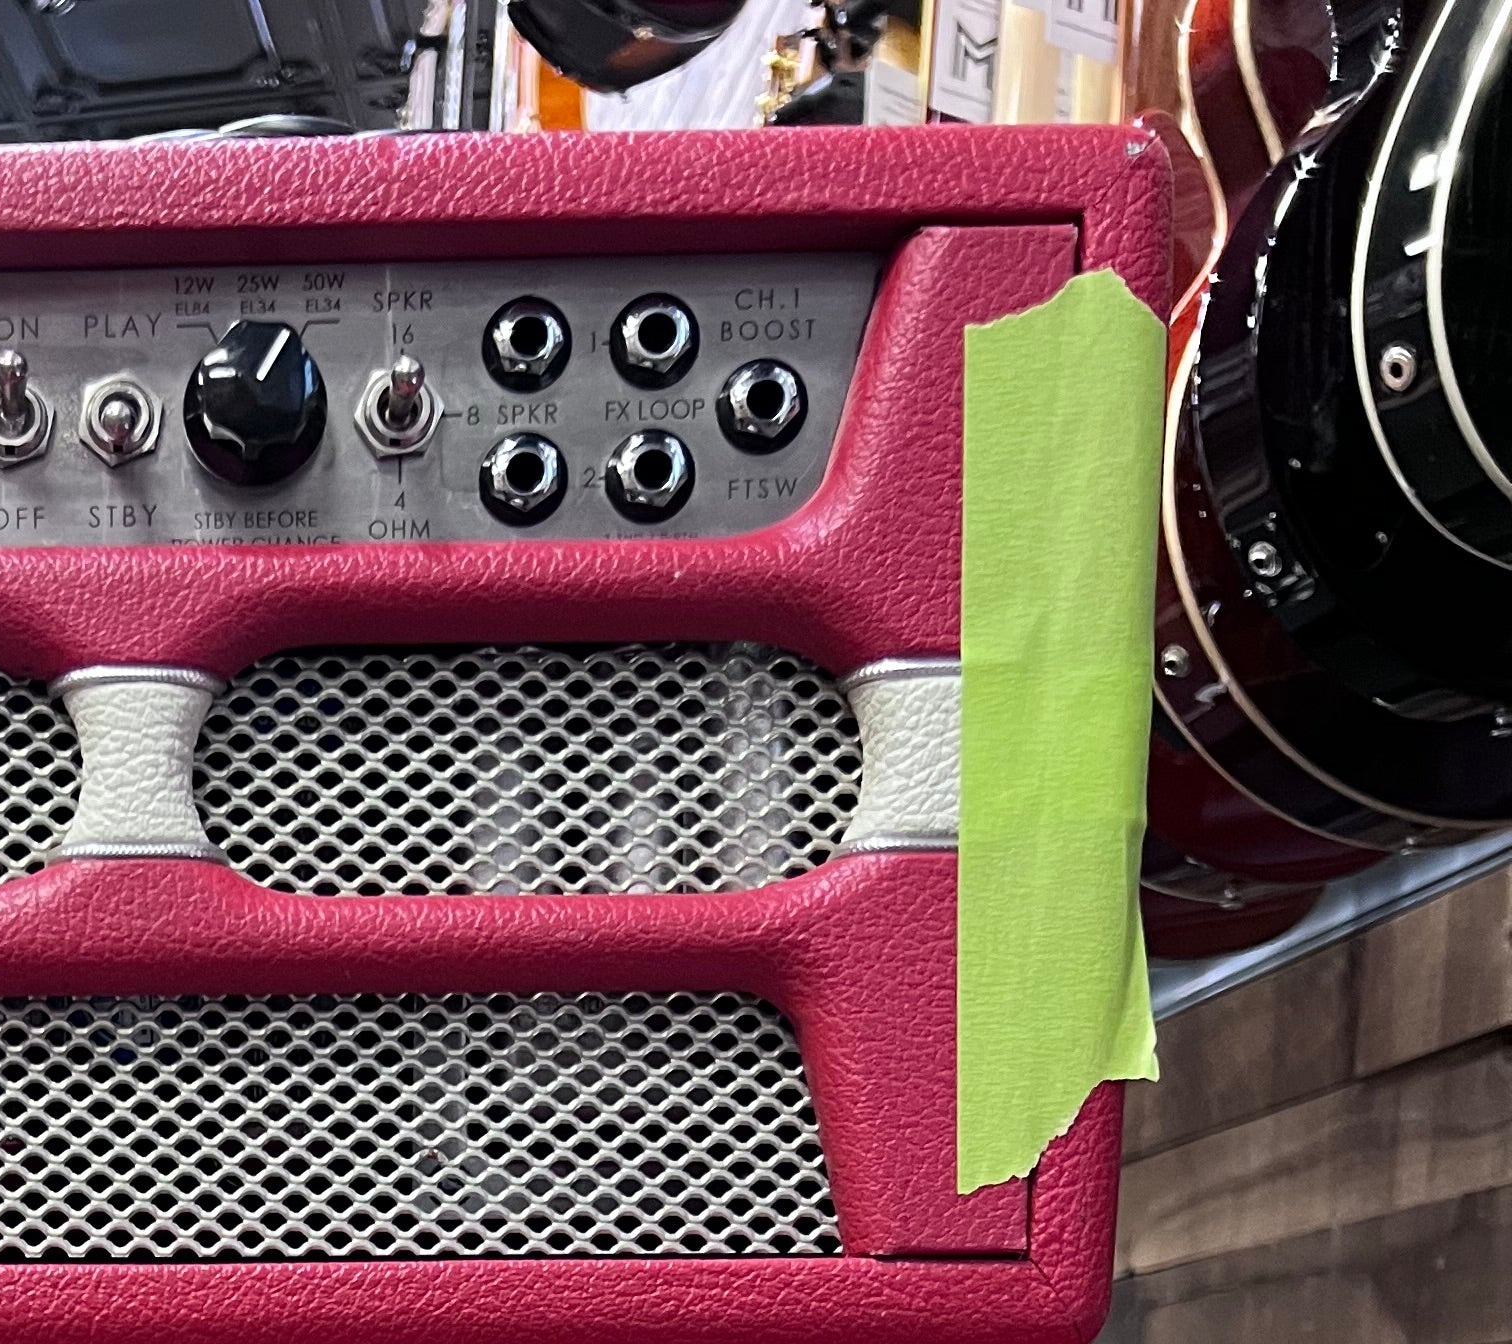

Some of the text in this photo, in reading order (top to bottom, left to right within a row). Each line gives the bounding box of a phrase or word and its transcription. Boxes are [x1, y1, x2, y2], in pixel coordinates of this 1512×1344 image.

[175, 272, 345, 295] 12W 25W 50W
[240, 299, 276, 315] EL34
[304, 297, 341, 313] EL34
[373, 291, 433, 312] SPKR
[84, 314, 162, 338] PLAY
[391, 325, 414, 344] 16
[720, 319, 816, 342] BOOST
[467, 408, 480, 426] 8
[497, 404, 558, 424] SPKR
[605, 399, 705, 422] FX LOOP
[584, 468, 595, 489] 2
[728, 479, 798, 500] FTSW
[394, 497, 407, 511] 4
[88, 505, 158, 528] STBY
[194, 510, 318, 530] STBY BEFORE
[368, 520, 430, 540] OHM
